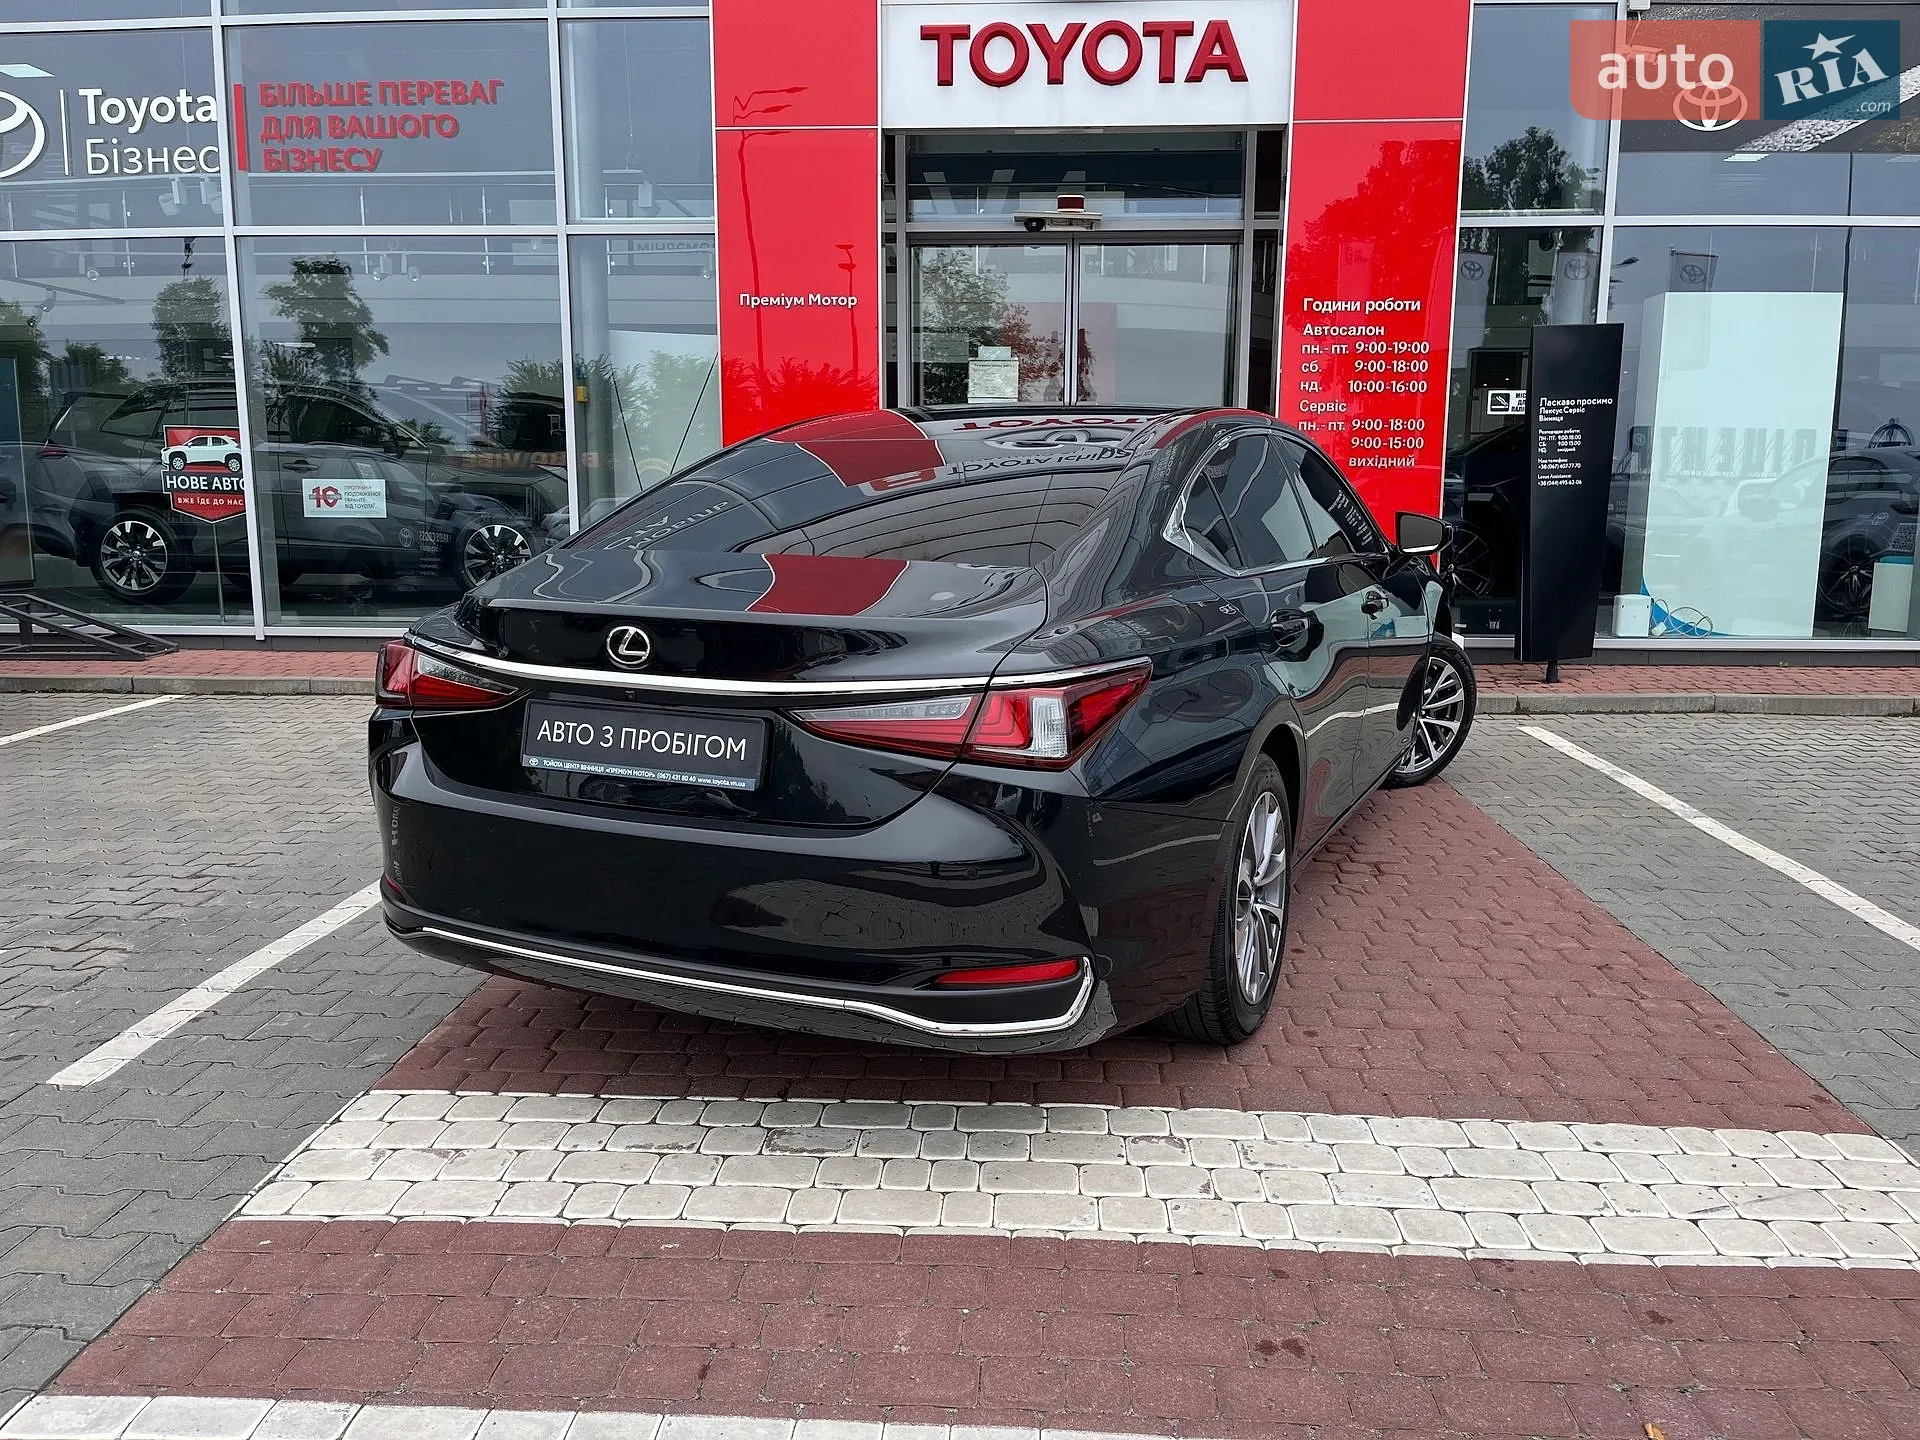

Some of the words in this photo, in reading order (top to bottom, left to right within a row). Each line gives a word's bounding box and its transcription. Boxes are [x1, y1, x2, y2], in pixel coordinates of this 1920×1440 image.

[920, 20, 1248, 87] TOYOTA
[259, 81, 372, 107] БІЛЬШЕ
[377, 79, 504, 107] ПЕРЕВАГ
[78, 88, 218, 134] Toyota
[260, 114, 322, 144] ДЛЯ
[327, 113, 461, 140] ВАШОГО
[85, 137, 220, 175] Бізнес
[263, 147, 383, 173] БІЗНЕСУ
[739, 293, 805, 309] Преміум
[808, 293, 858, 309] Мотор
[1303, 297, 1361, 314] Години
[1365, 297, 1421, 315] роботи
[1303, 323, 1385, 336] Автосалон
[1355, 341, 1430, 354] 9:00-19:00
[1301, 360, 1322, 373] сб.
[1354, 360, 1429, 373] 9:00-18:00
[1300, 381, 1322, 392] нд.
[1348, 380, 1428, 393] 10:00-16:00
[1299, 399, 1347, 414] Сервіс
[1539, 397, 1576, 407] Ласкаво
[1576, 398, 1614, 407] просимо
[1351, 419, 1425, 431] 9:00-18:00
[1351, 436, 1424, 449] 9:00-15:00
[1348, 455, 1415, 468] вихідний
[166, 475, 208, 490] НОВЕ
[196, 496, 210, 505] ЇДЕ
[536, 719, 595, 746] АВТО
[599, 725, 614, 748] З
[620, 727, 747, 761] ПРОБІГОМ
